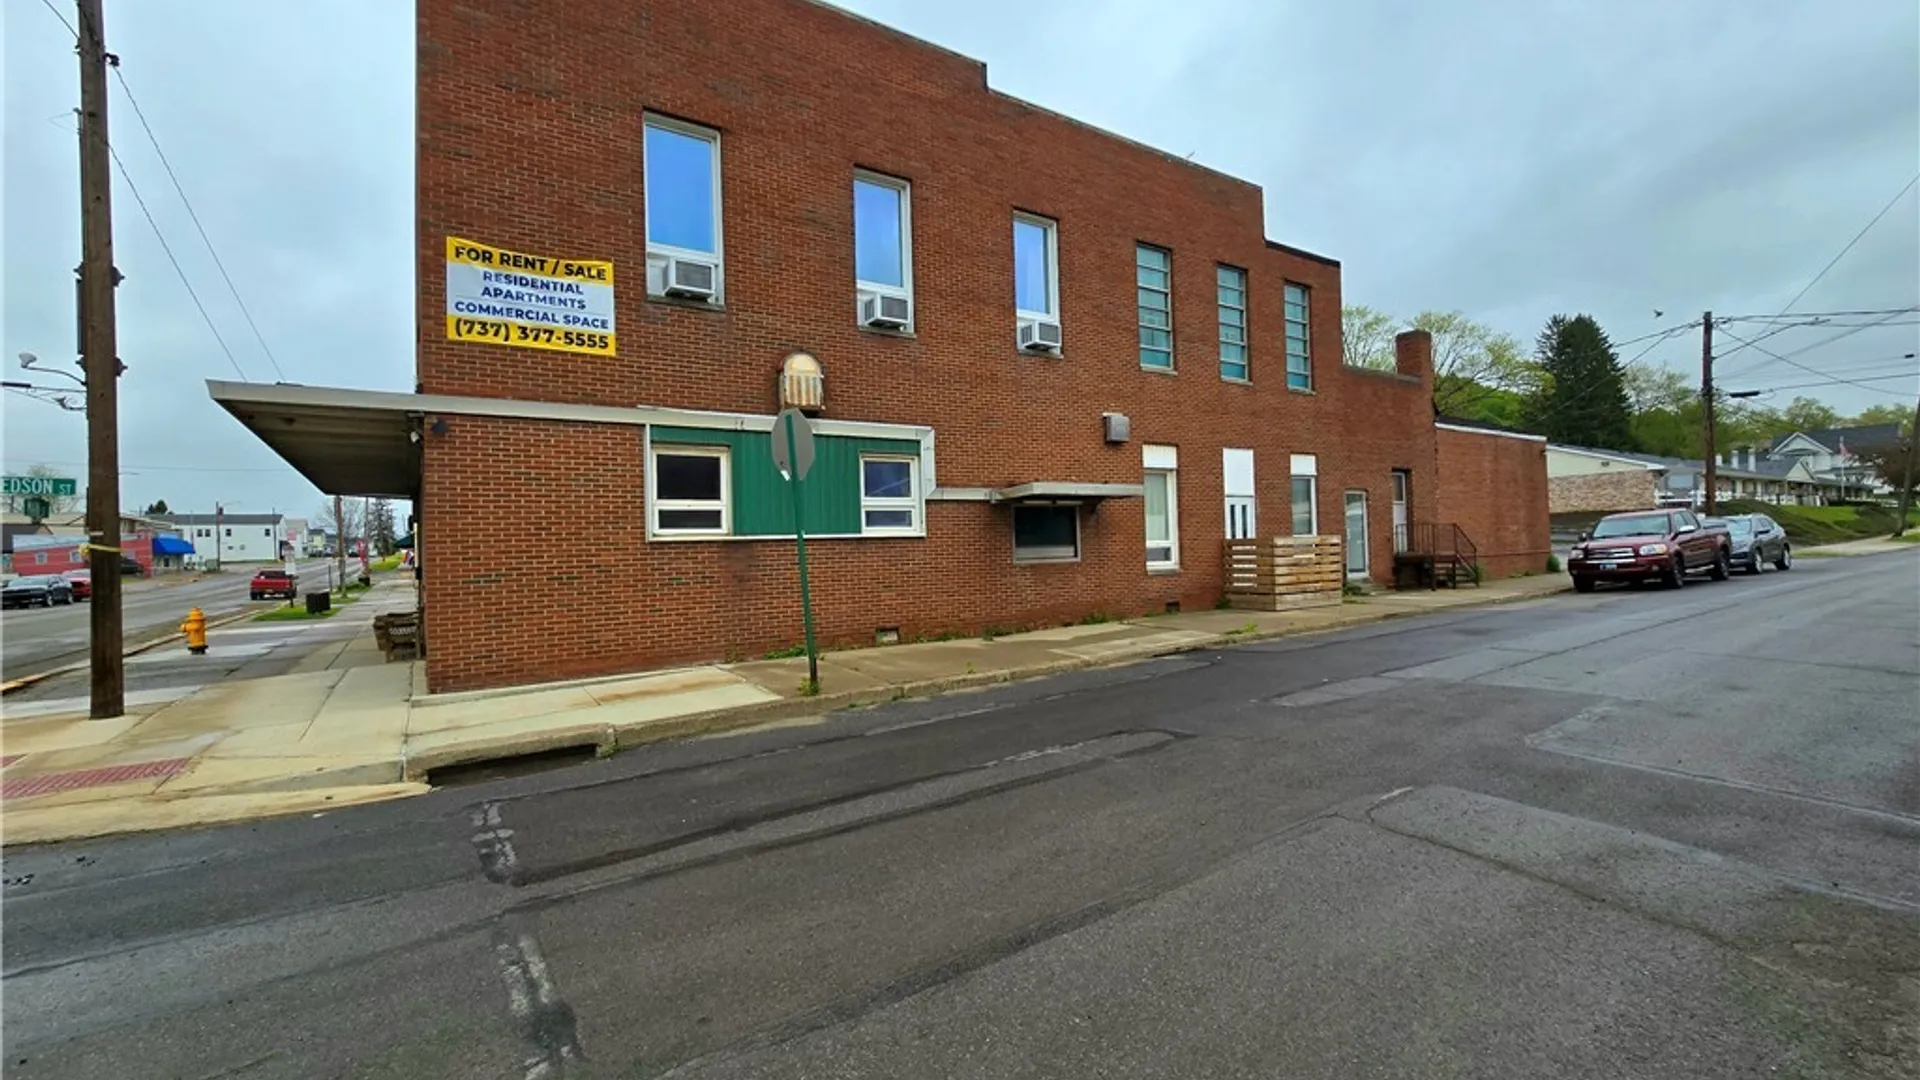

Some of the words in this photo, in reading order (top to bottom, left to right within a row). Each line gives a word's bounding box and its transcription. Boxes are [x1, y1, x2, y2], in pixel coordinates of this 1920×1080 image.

[455, 247, 493, 263] FOR
[500, 251, 548, 271] RENT
[551, 260, 560, 275] /
[564, 263, 607, 280] SALE
[483, 271, 584, 295] RESIDENTIAL
[481, 287, 587, 310] APARTMENTS
[454, 301, 559, 324] COMMERCIAL
[562, 315, 609, 329] SPACE
[455, 318, 510, 342] (737)
[517, 325, 609, 349] 377-5555
[1, 478, 53, 494] EDSON
[59, 483, 72, 493] ST
